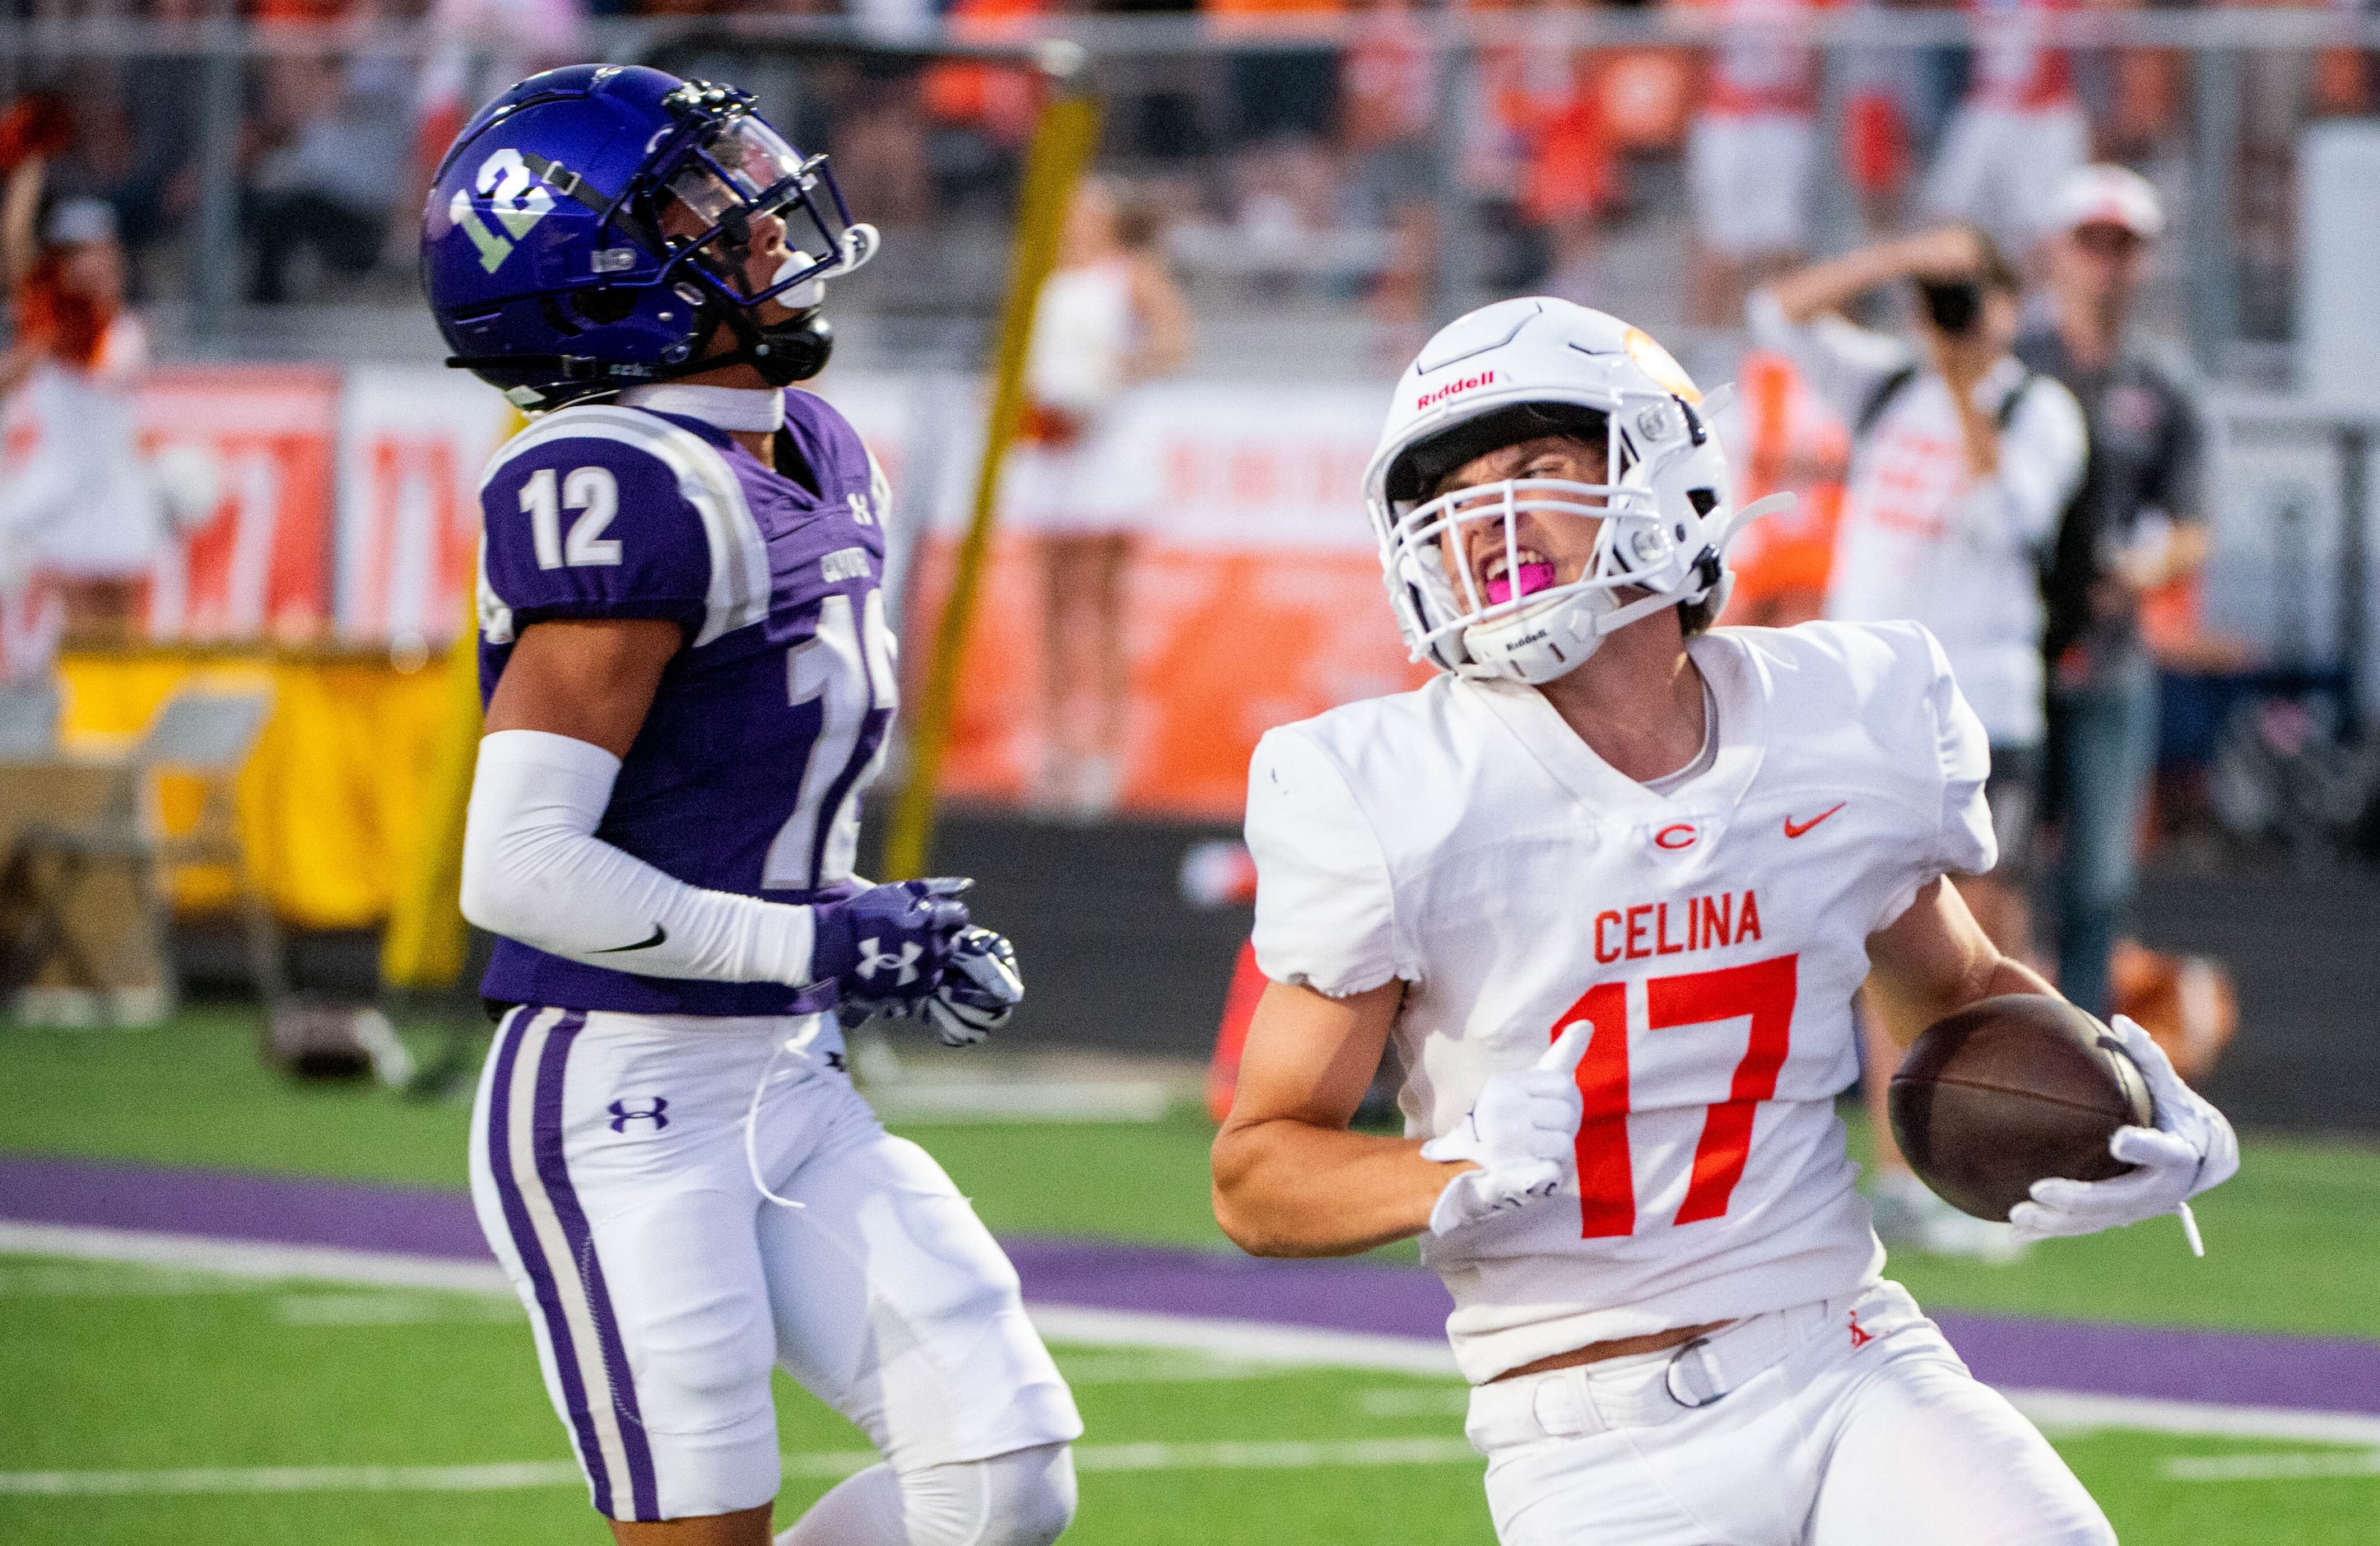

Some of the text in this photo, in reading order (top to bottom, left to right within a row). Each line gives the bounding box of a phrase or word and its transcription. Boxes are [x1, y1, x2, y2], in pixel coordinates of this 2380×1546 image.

[449, 148, 558, 274] 12
[1417, 370, 1494, 410] Riddell
[518, 466, 624, 570] 12
[1655, 824, 1697, 849] C
[1594, 889, 1763, 965] CELINA
[1550, 952, 1800, 1238] 17
